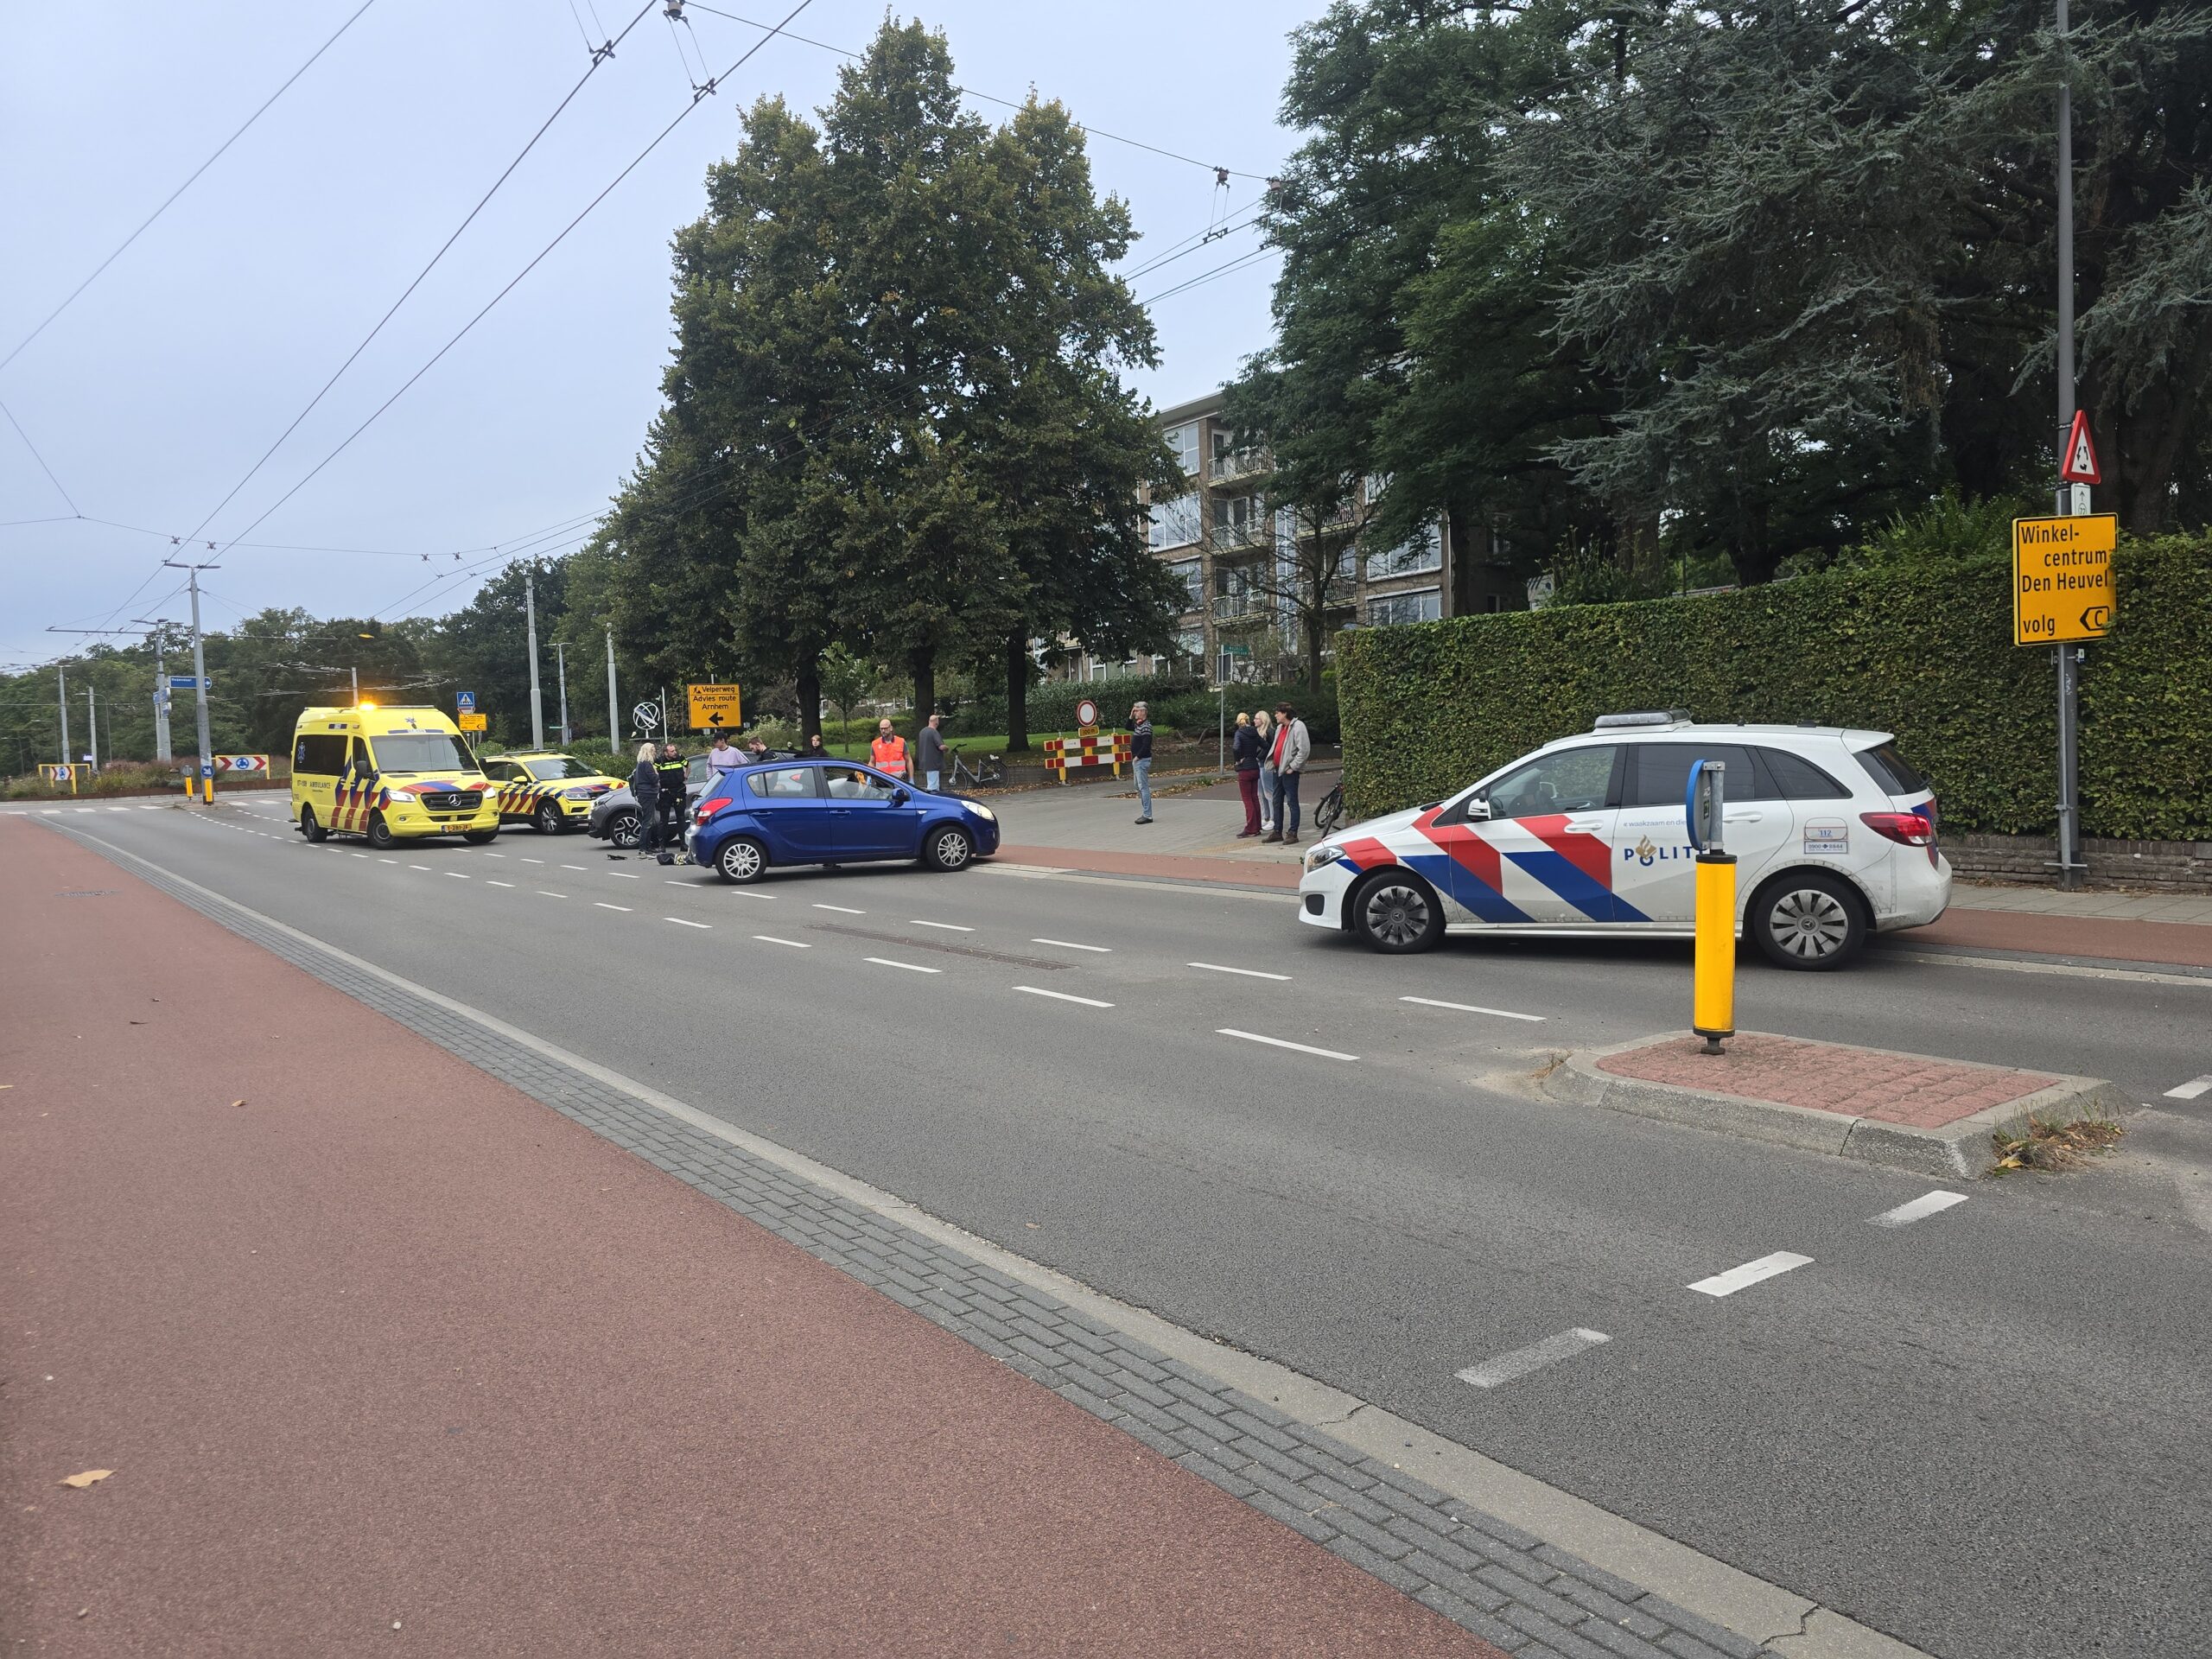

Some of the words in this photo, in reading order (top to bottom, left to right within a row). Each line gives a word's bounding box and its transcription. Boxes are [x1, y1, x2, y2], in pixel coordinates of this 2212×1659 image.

[2020, 523, 2080, 544] Winkel-
[2044, 549, 2107, 567] centrum
[2022, 574, 2051, 593] Den
[2057, 569, 2108, 590] Heuvel
[2023, 615, 2055, 636] volg
[2094, 609, 2103, 627] C
[1624, 846, 1702, 867] POLIT
